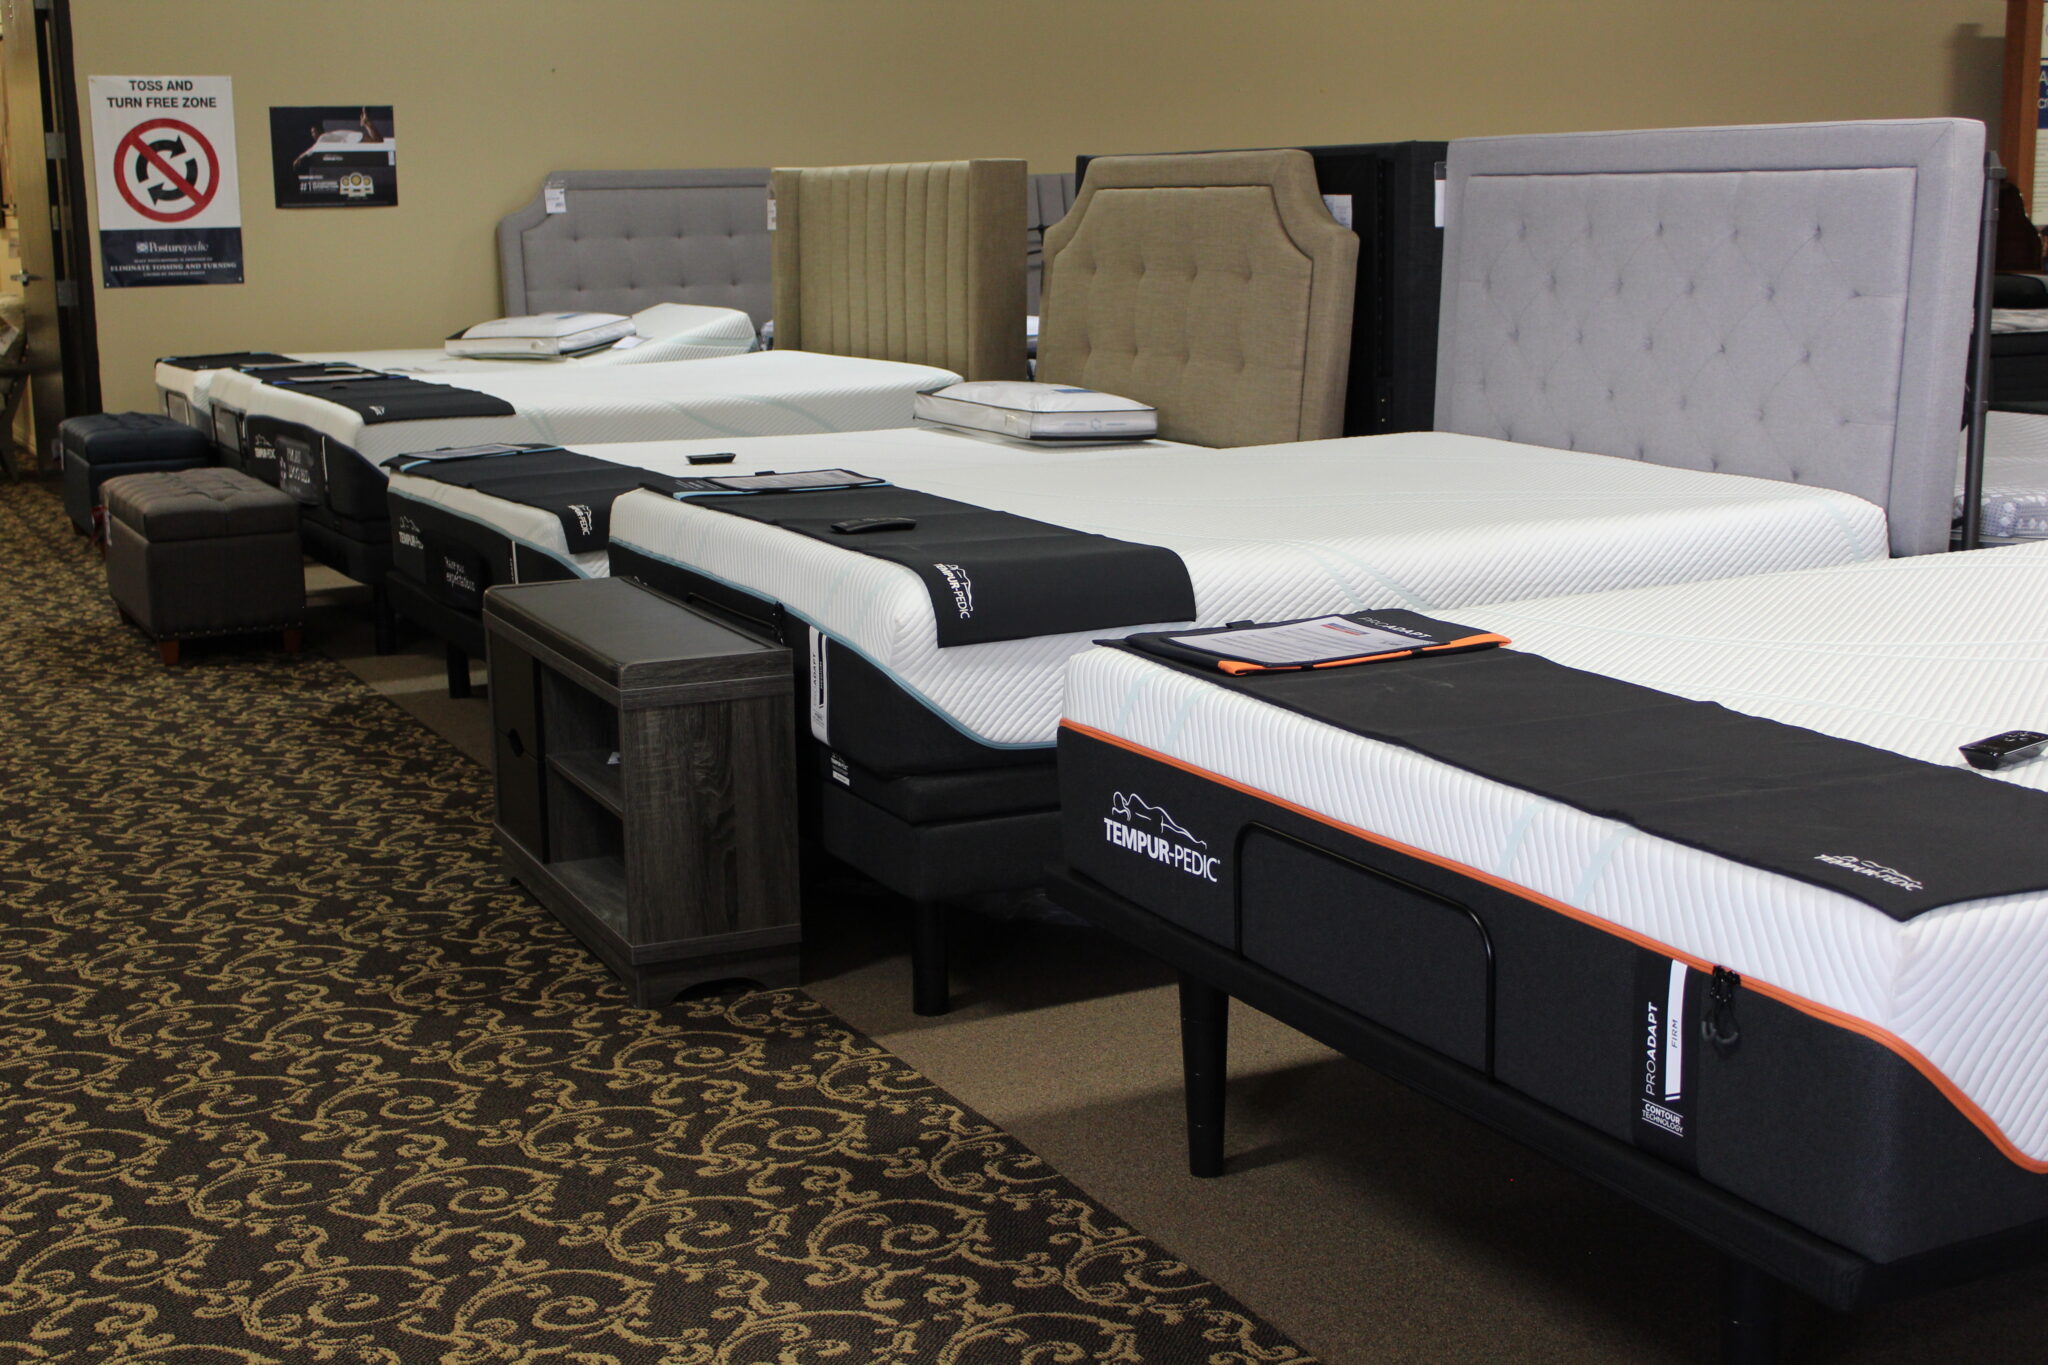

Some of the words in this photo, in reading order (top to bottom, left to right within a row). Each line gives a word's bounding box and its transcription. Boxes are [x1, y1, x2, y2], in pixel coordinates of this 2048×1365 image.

[129, 80, 163, 91] TOSS
[167, 80, 193, 91] AND
[107, 97, 142, 108] TURN
[146, 97, 179, 108] FREE
[182, 97, 217, 108] ZONE
[110, 264, 150, 272] ELIMINATE
[152, 263, 184, 271] TOSSING
[185, 262, 202, 270] AND
[203, 261, 237, 269] TURNING
[1104, 817, 1219, 882] TEMPUR-PEDIC
[1645, 1001, 1658, 1096] PROADAPT
[1642, 1110, 1684, 1133] TECHNOLOGY
[1645, 1103, 1681, 1125] CONTOUR
